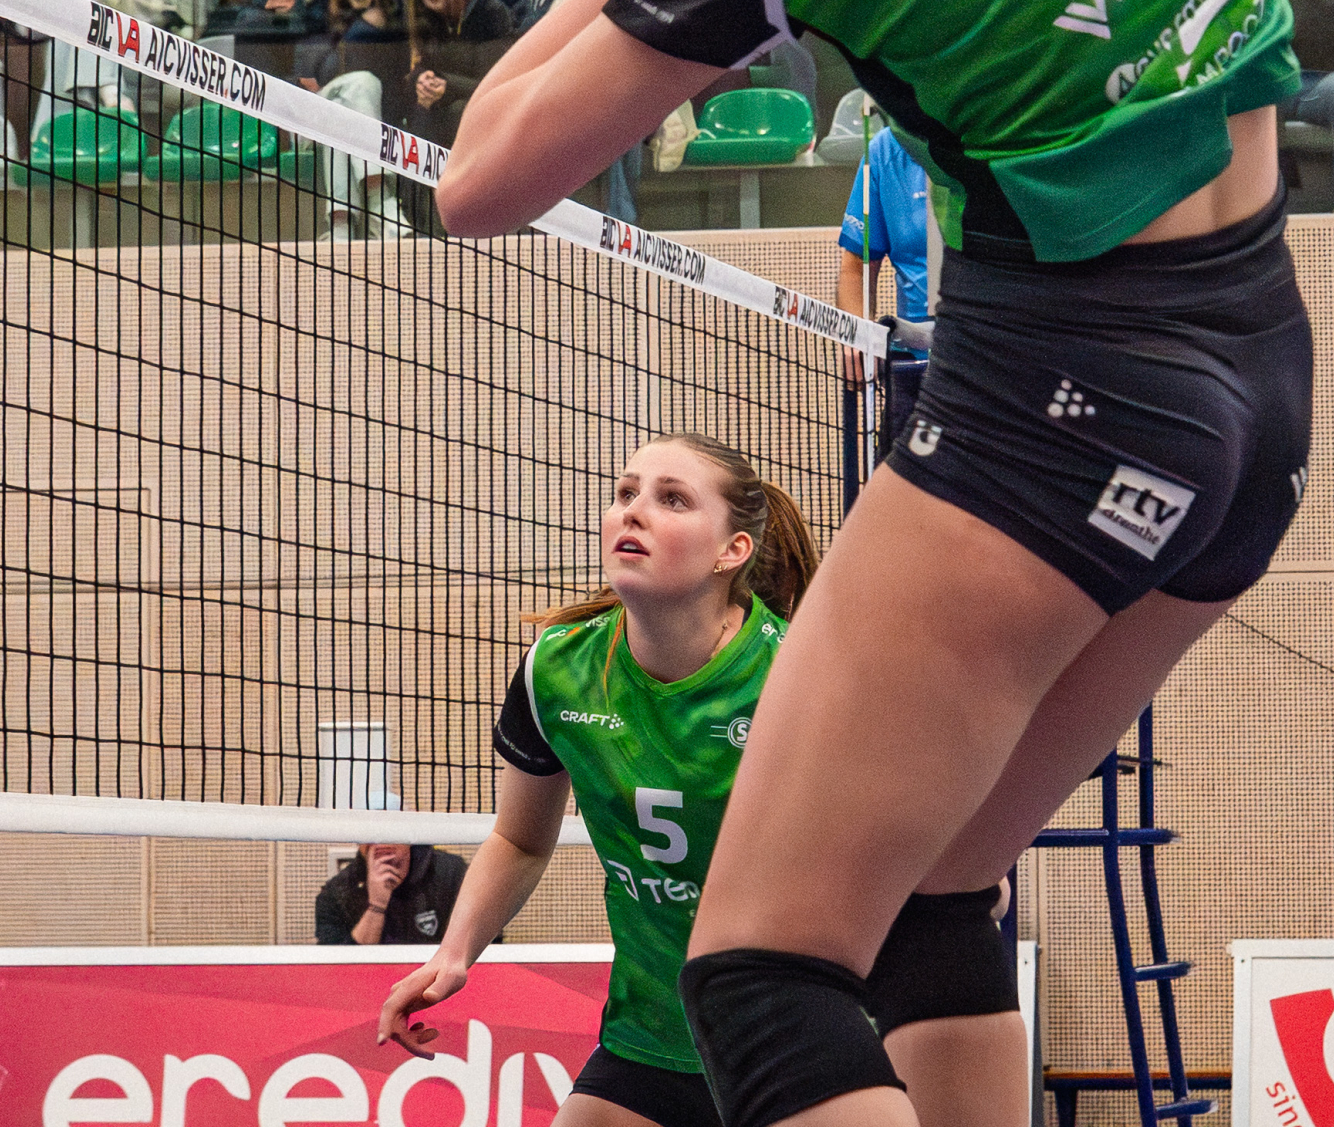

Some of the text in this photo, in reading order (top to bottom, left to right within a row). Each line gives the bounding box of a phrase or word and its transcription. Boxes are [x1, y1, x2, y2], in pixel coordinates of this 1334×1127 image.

[144, 27, 267, 113] AICVISSER.COM
[633, 228, 707, 286] AICVISSER.COM
[1112, 482, 1181, 526] rtv
[559, 709, 611, 727] CRAFT
[635, 786, 689, 864] 5
